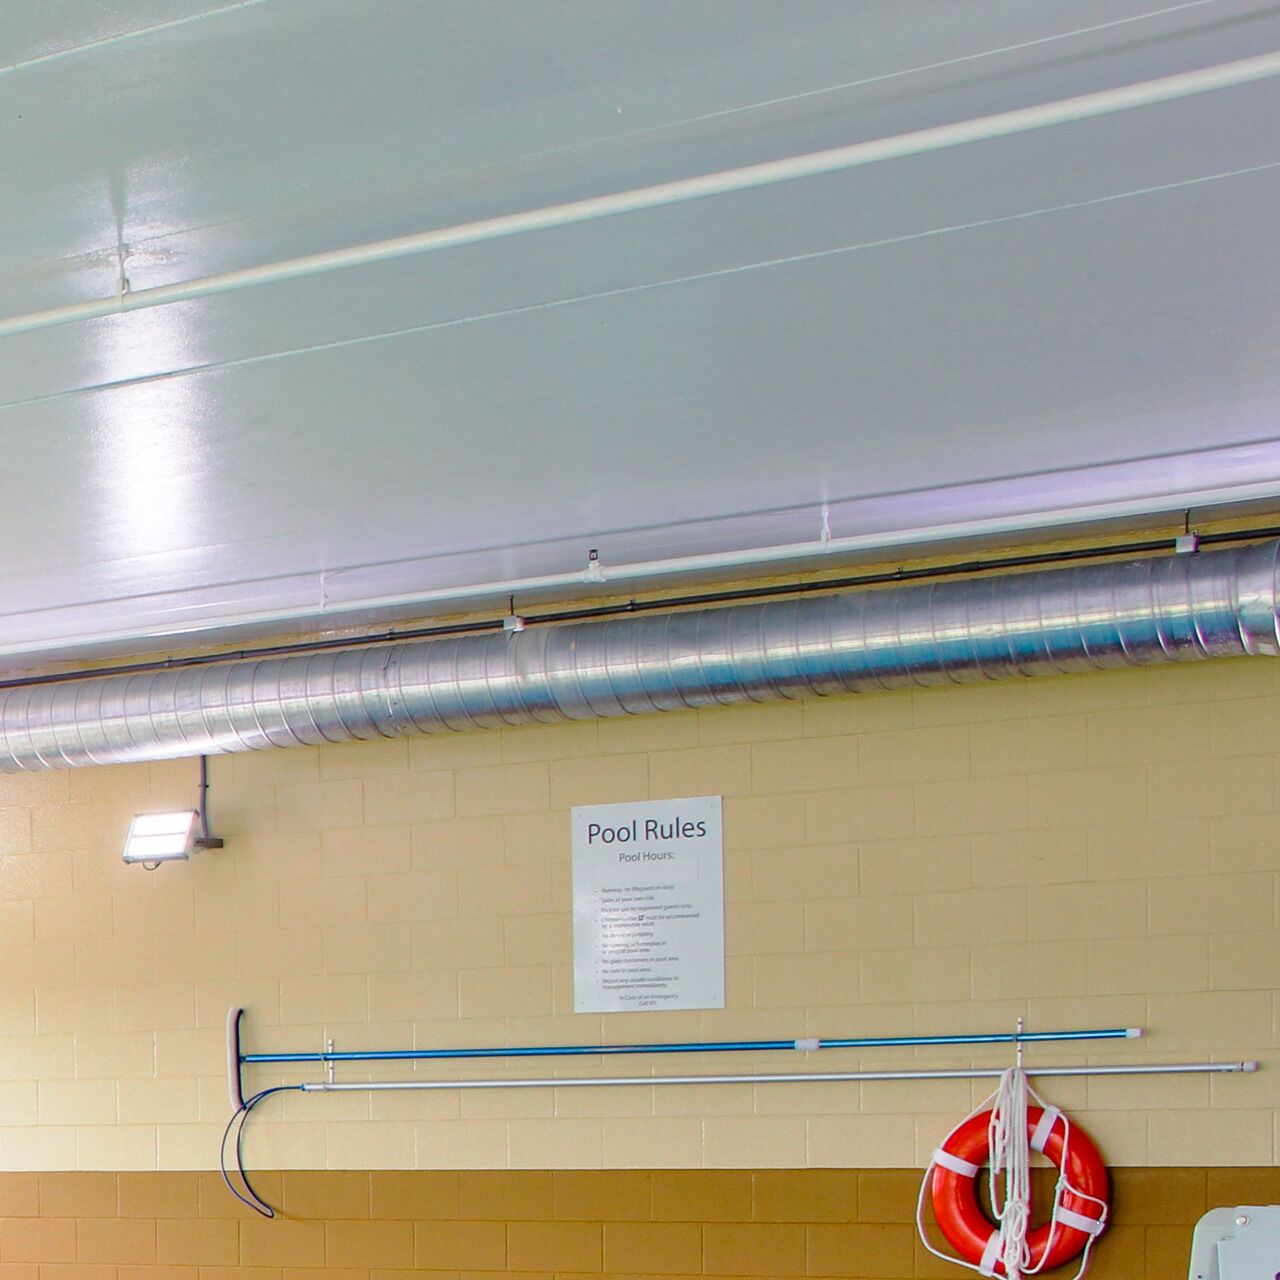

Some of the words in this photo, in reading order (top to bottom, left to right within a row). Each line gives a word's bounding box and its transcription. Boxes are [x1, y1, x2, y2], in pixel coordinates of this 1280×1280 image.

[588, 819, 637, 845] Pool
[644, 816, 707, 841] Rules
[618, 851, 641, 863] Pool
